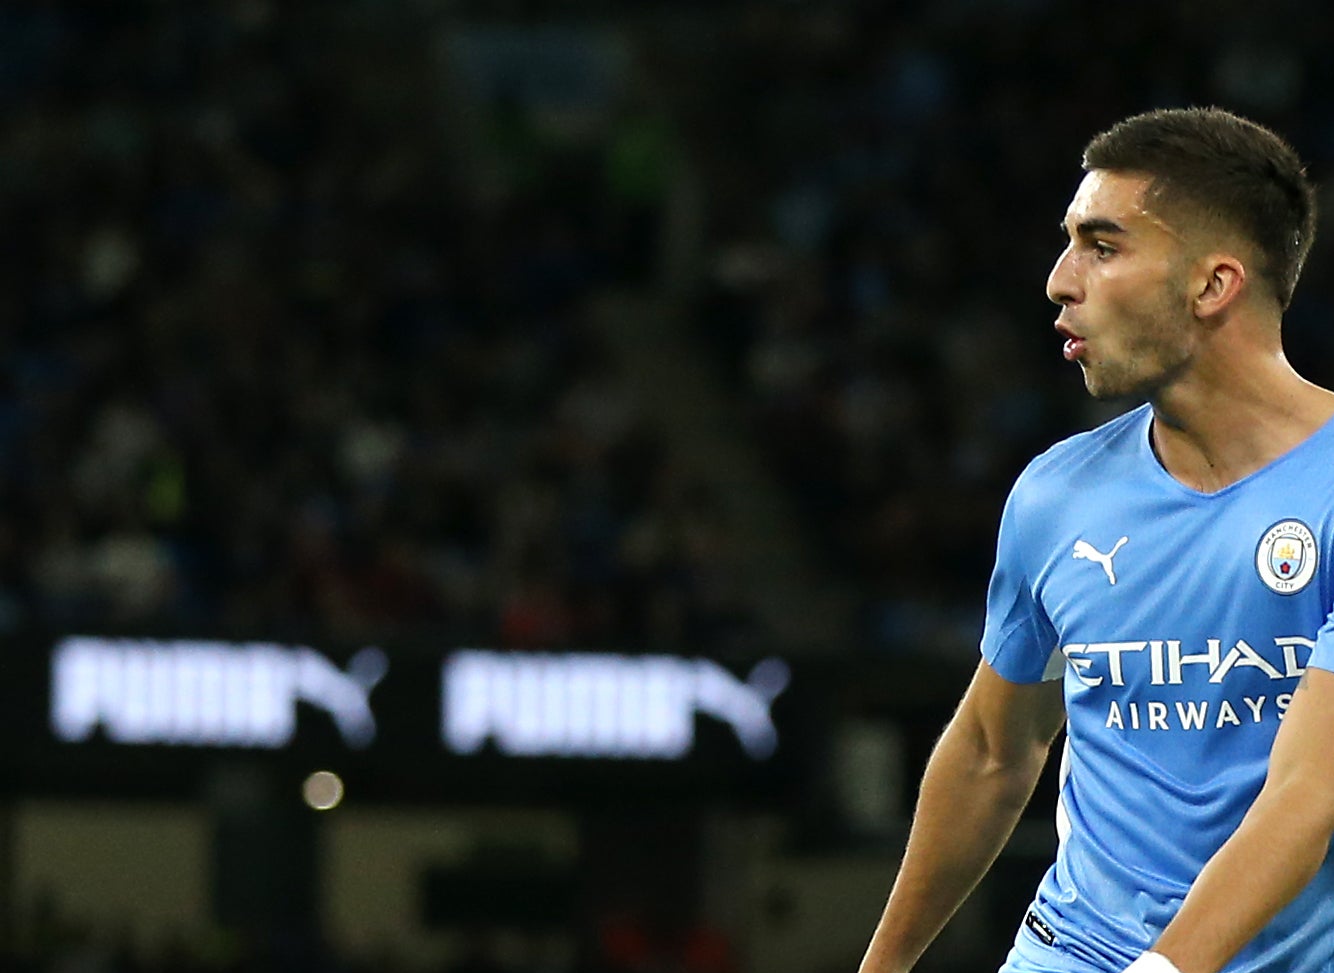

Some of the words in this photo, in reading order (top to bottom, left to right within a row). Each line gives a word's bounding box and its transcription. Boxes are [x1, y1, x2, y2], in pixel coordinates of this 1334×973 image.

[1265, 524, 1313, 549] MANCHESTER
[1275, 581, 1295, 590] CITY
[1061, 635, 1317, 688] ETIHAD
